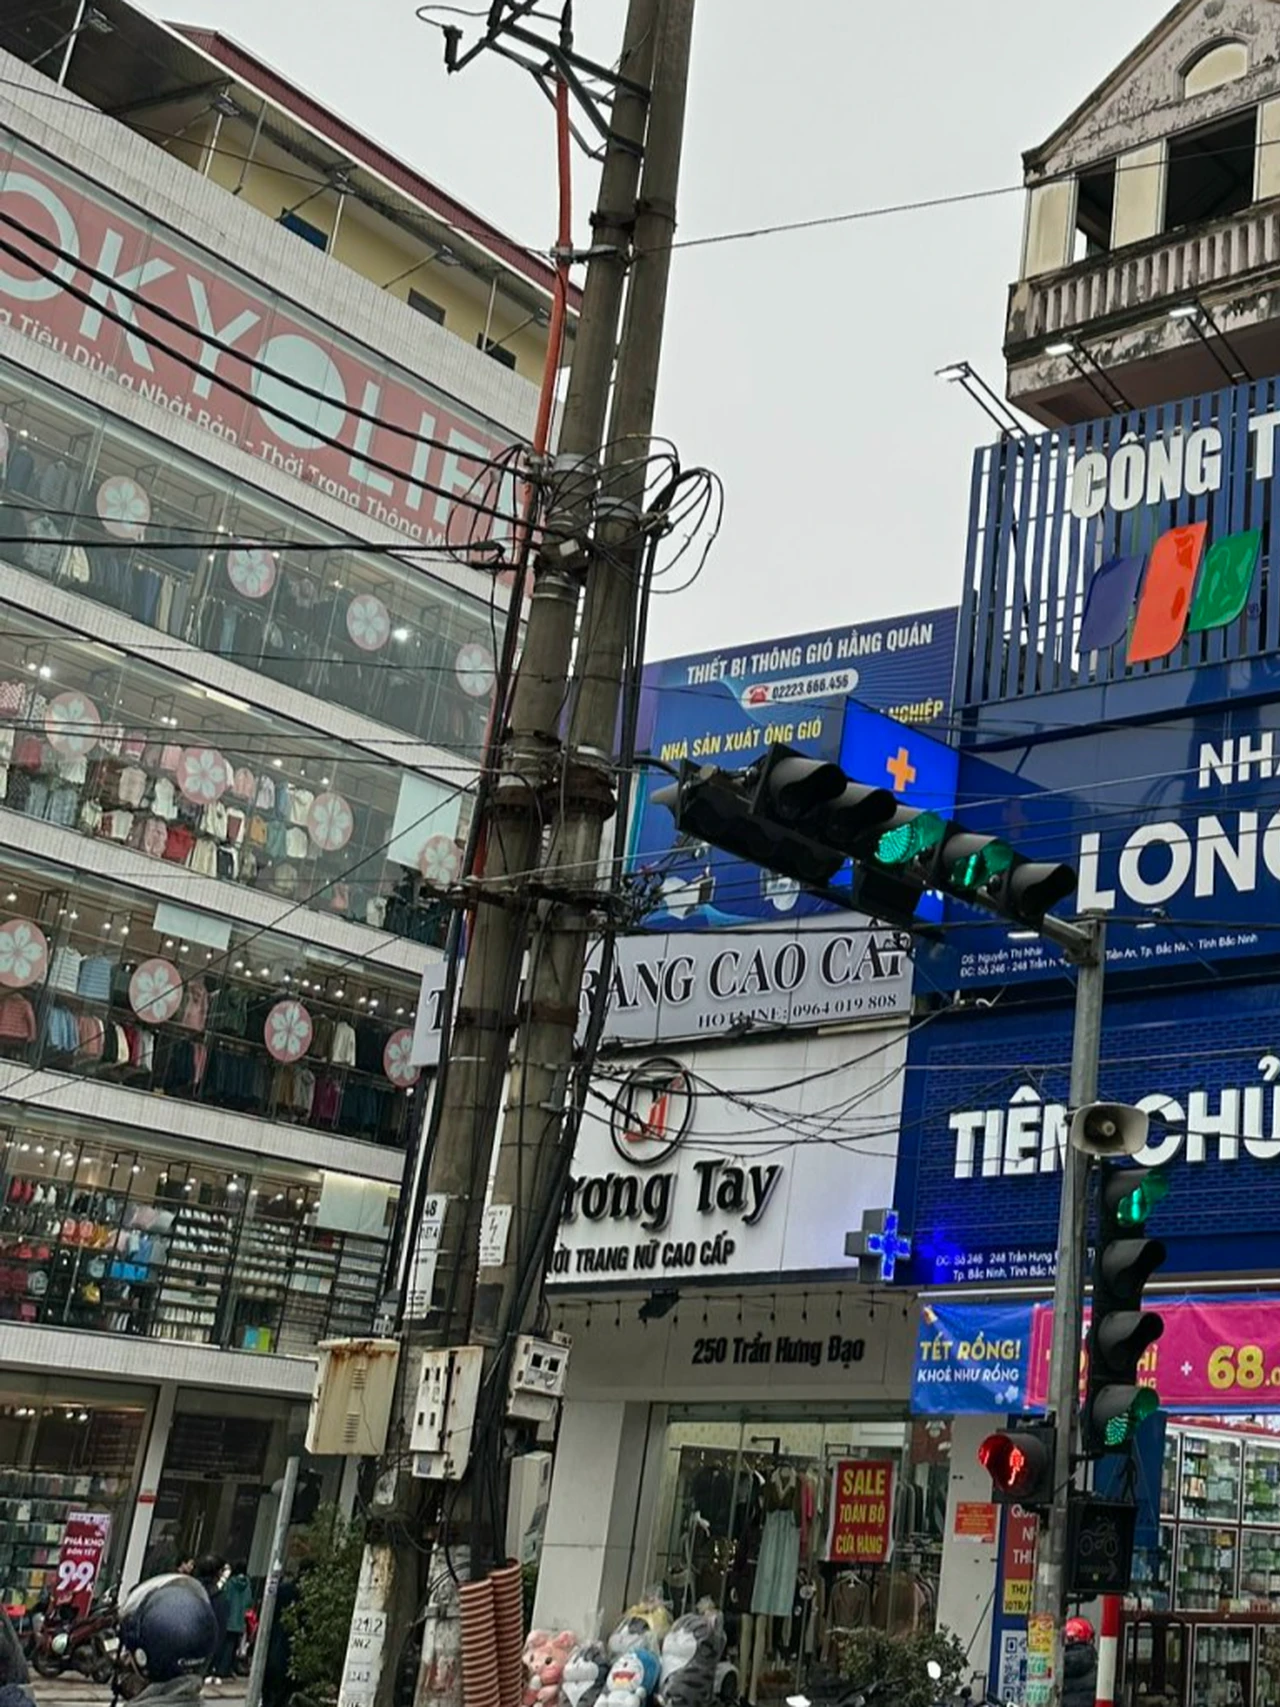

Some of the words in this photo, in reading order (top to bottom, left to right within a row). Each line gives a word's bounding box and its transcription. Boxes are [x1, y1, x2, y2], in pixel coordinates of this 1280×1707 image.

[20, 314, 68, 353] Tiêu
[138, 377, 192, 420] Nhật
[196, 410, 237, 444] Bản
[308, 464, 361, 508] Trang
[366, 497, 421, 541] Thông
[1071, 427, 1223, 519] CÔNG
[687, 655, 728, 685] THIẾT
[731, 657, 747, 681] BỊ
[750, 648, 801, 675] THÔNG
[806, 637, 832, 664] GIÓ
[886, 621, 933, 650] QUÁN
[660, 739, 688, 761] NHÀ
[692, 732, 721, 757] SẢN
[724, 721, 761, 751] XUẤT
[797, 716, 822, 740] GIÓ
[579, 956, 694, 1013] RANG
[709, 943, 806, 997] CAO
[793, 1002, 830, 1017] 0964
[835, 998, 863, 1012] 019
[868, 994, 897, 1009] 808
[576, 1247, 628, 1272] TRANG
[633, 1237, 660, 1269] NỮ
[662, 1241, 695, 1268] CAO
[700, 1230, 735, 1266] CẤP
[692, 1337, 727, 1365] 250
[775, 1336, 823, 1367] Hưng
[827, 1335, 866, 1369] Đạo
[920, 1331, 953, 1361] TẾT
[954, 1368, 981, 1382] NHƯ
[842, 1469, 886, 1496] SALE
[856, 1532, 883, 1554] HÀNG
